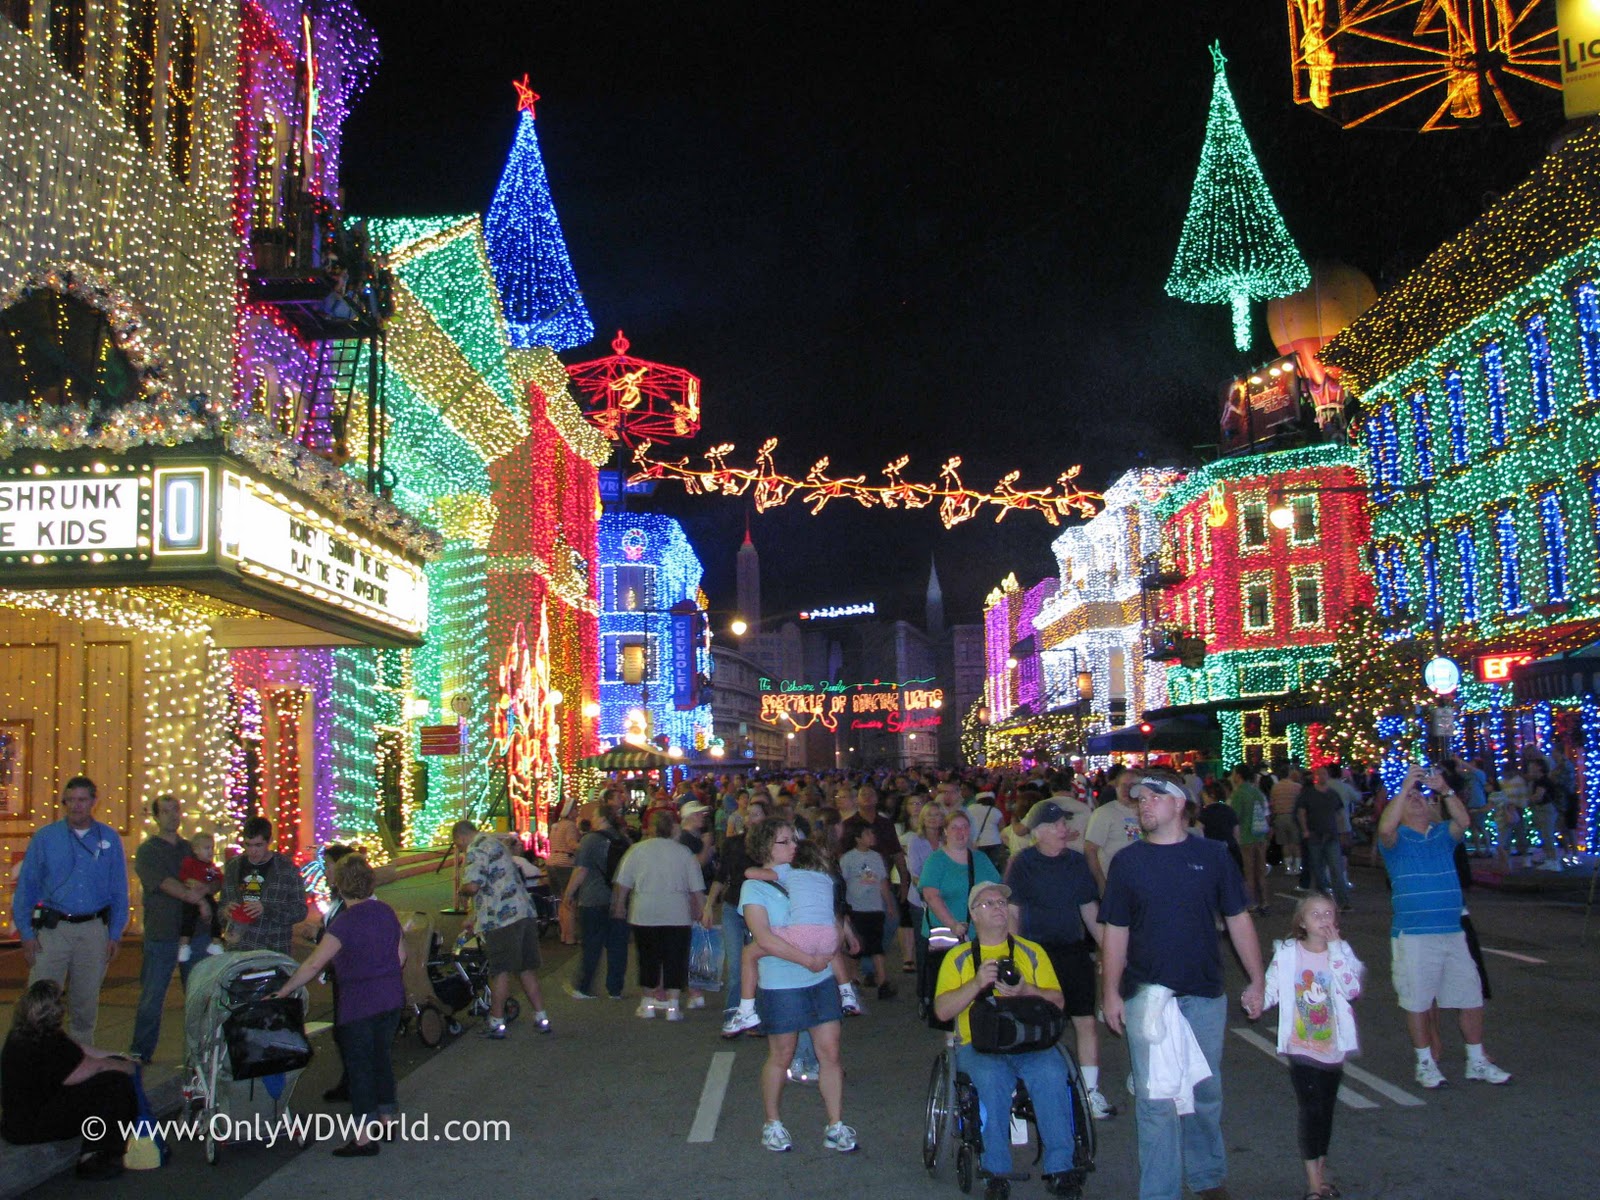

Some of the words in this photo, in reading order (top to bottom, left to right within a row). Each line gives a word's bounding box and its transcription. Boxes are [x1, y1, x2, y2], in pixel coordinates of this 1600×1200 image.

[0, 484, 122, 511] SHRUNK
[37, 519, 107, 546] KIDS
[675, 621, 687, 692] CHEVROLET
[759, 677, 772, 691] The
[831, 695, 847, 713] OF
